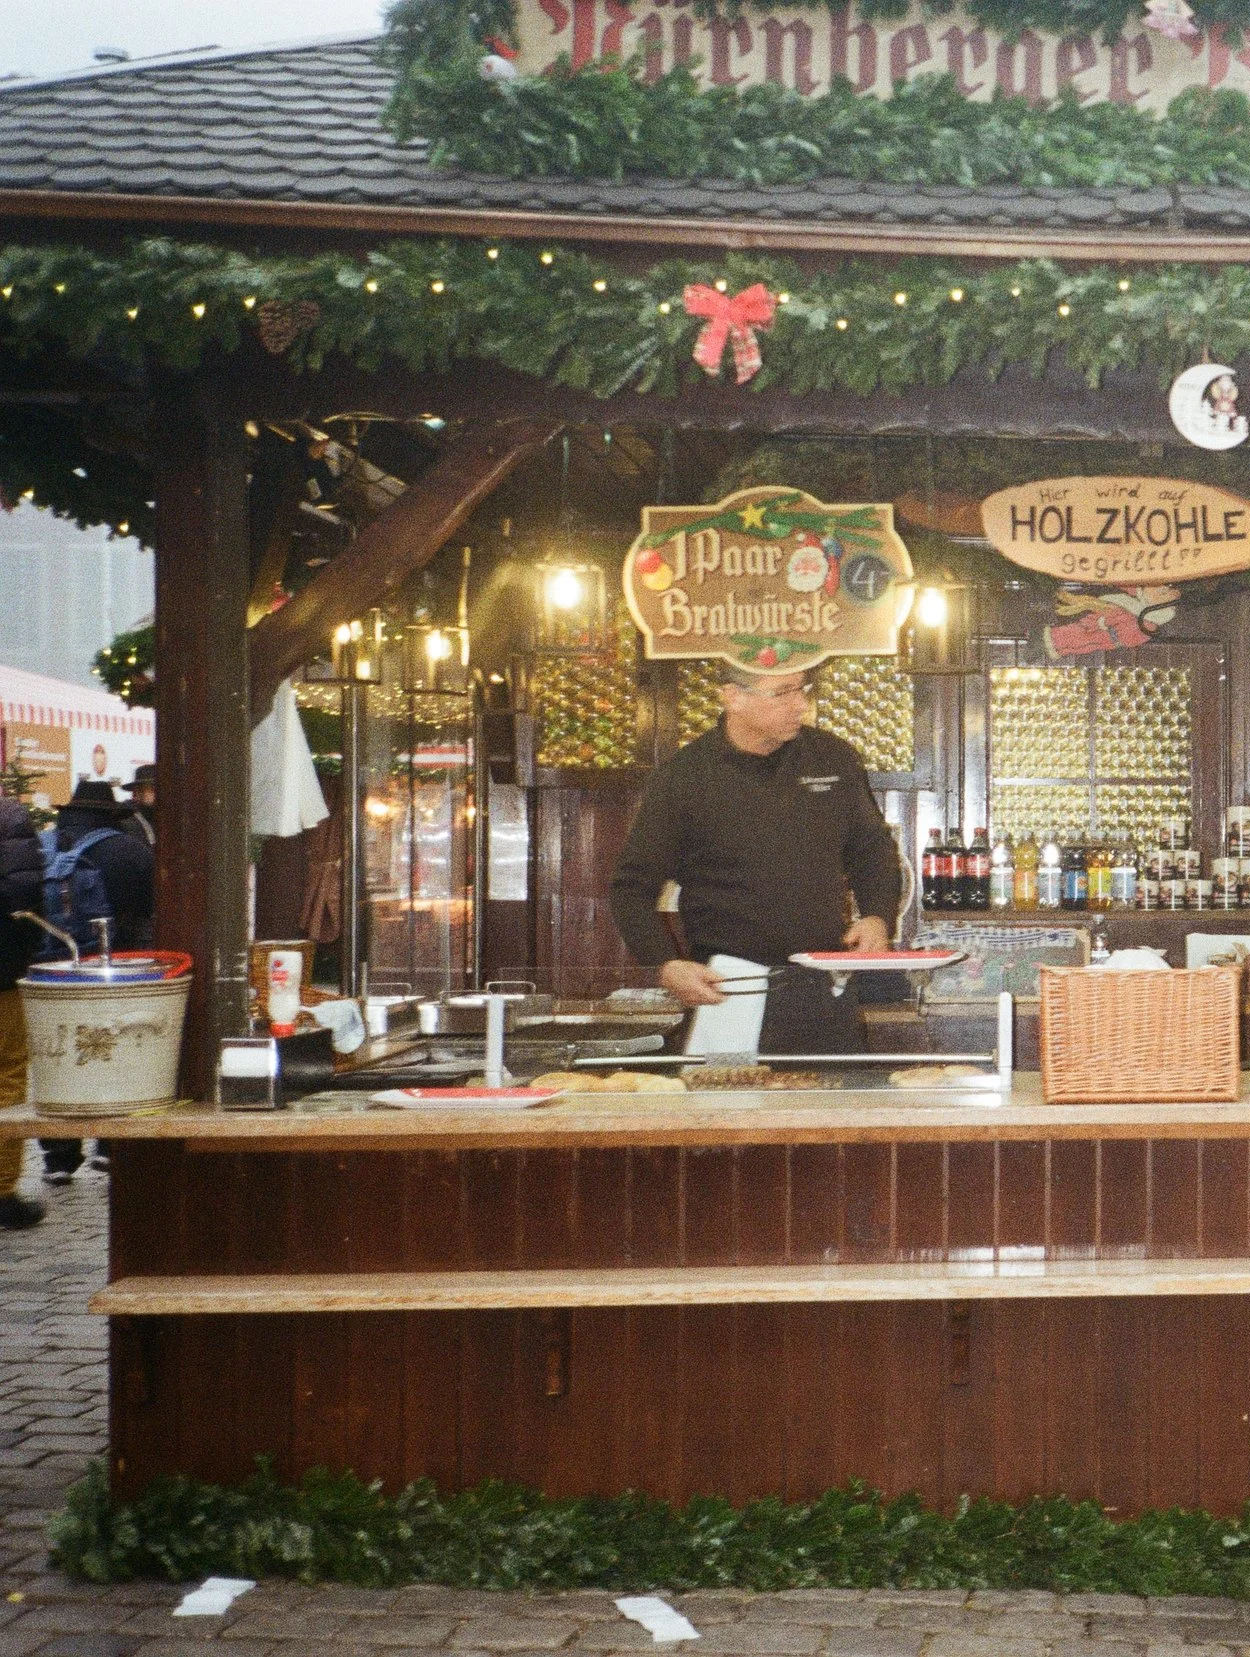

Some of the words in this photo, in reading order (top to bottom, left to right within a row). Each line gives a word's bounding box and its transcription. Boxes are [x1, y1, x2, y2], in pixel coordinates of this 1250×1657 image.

[1040, 488, 1071, 502] Hier
[1095, 482, 1141, 498] wird
[1159, 489, 1190, 505] auf
[1011, 504, 1247, 546] HOLZKOHLE
[688, 528, 783, 584] Paar
[657, 587, 843, 636] Bratwürste
